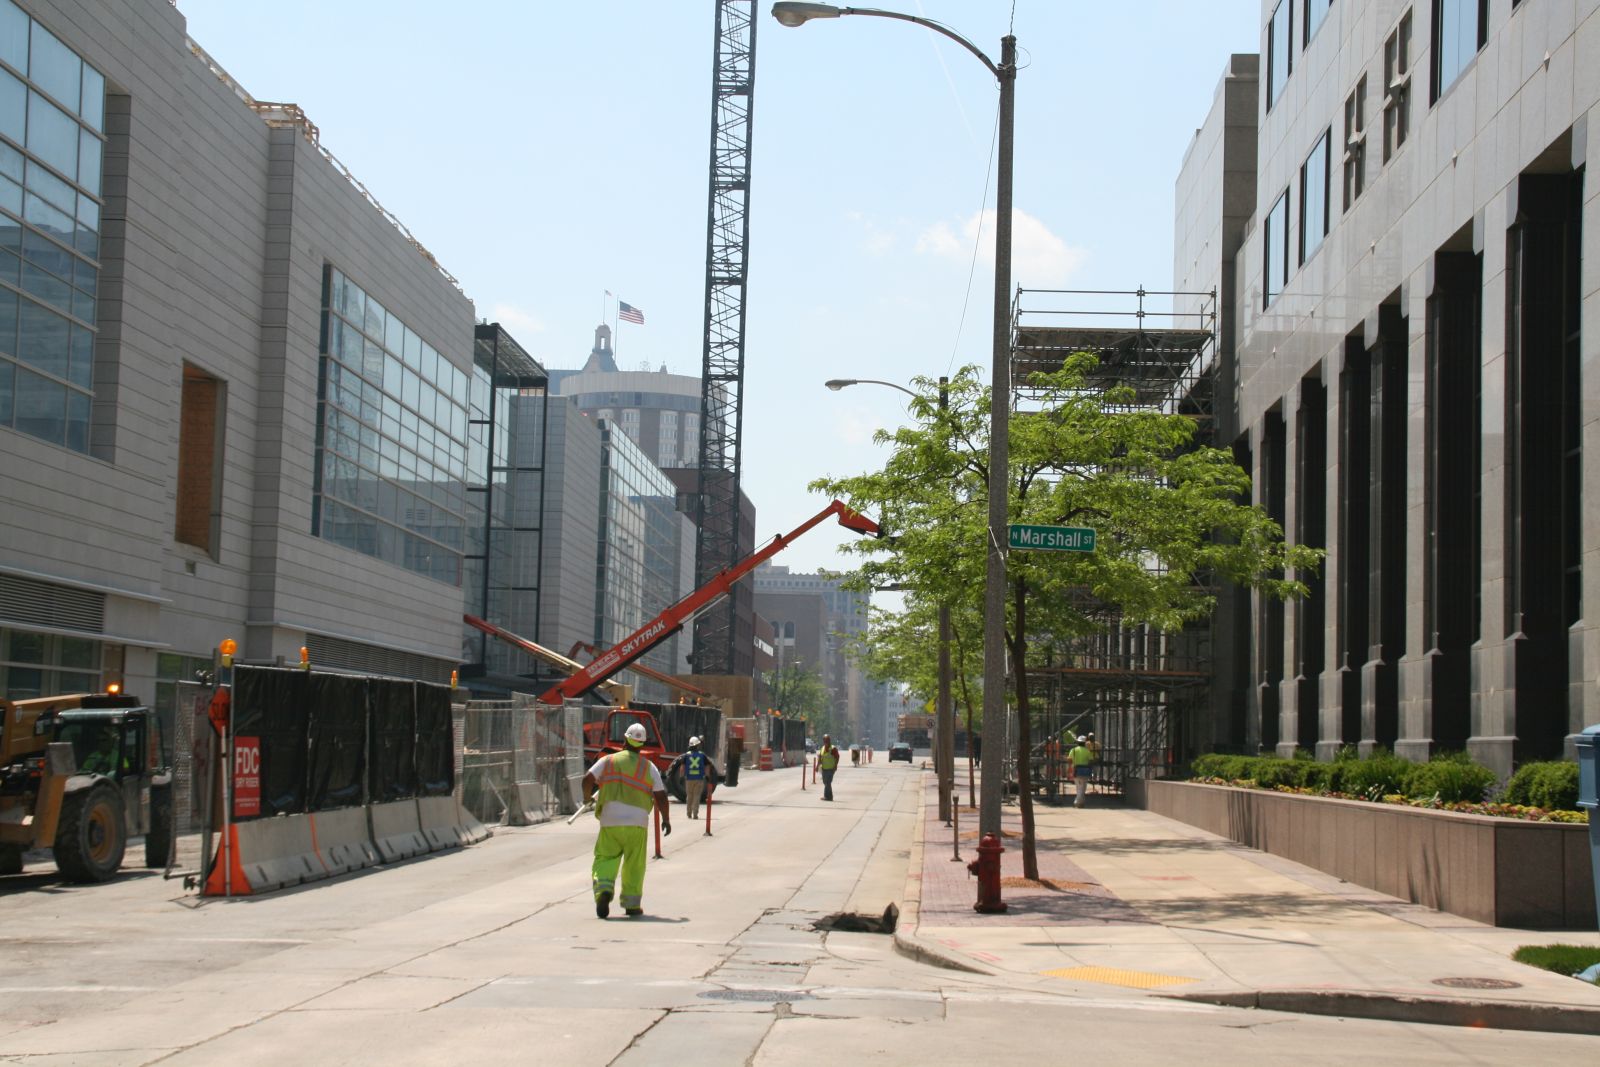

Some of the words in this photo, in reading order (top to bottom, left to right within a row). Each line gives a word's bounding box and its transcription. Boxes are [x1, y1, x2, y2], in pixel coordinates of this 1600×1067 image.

[1012, 531, 1018, 540] N
[1020, 528, 1081, 548] Marshall
[1083, 535, 1093, 545] ST
[621, 620, 666, 656] SKYTRAK
[235, 746, 260, 775] FDC
